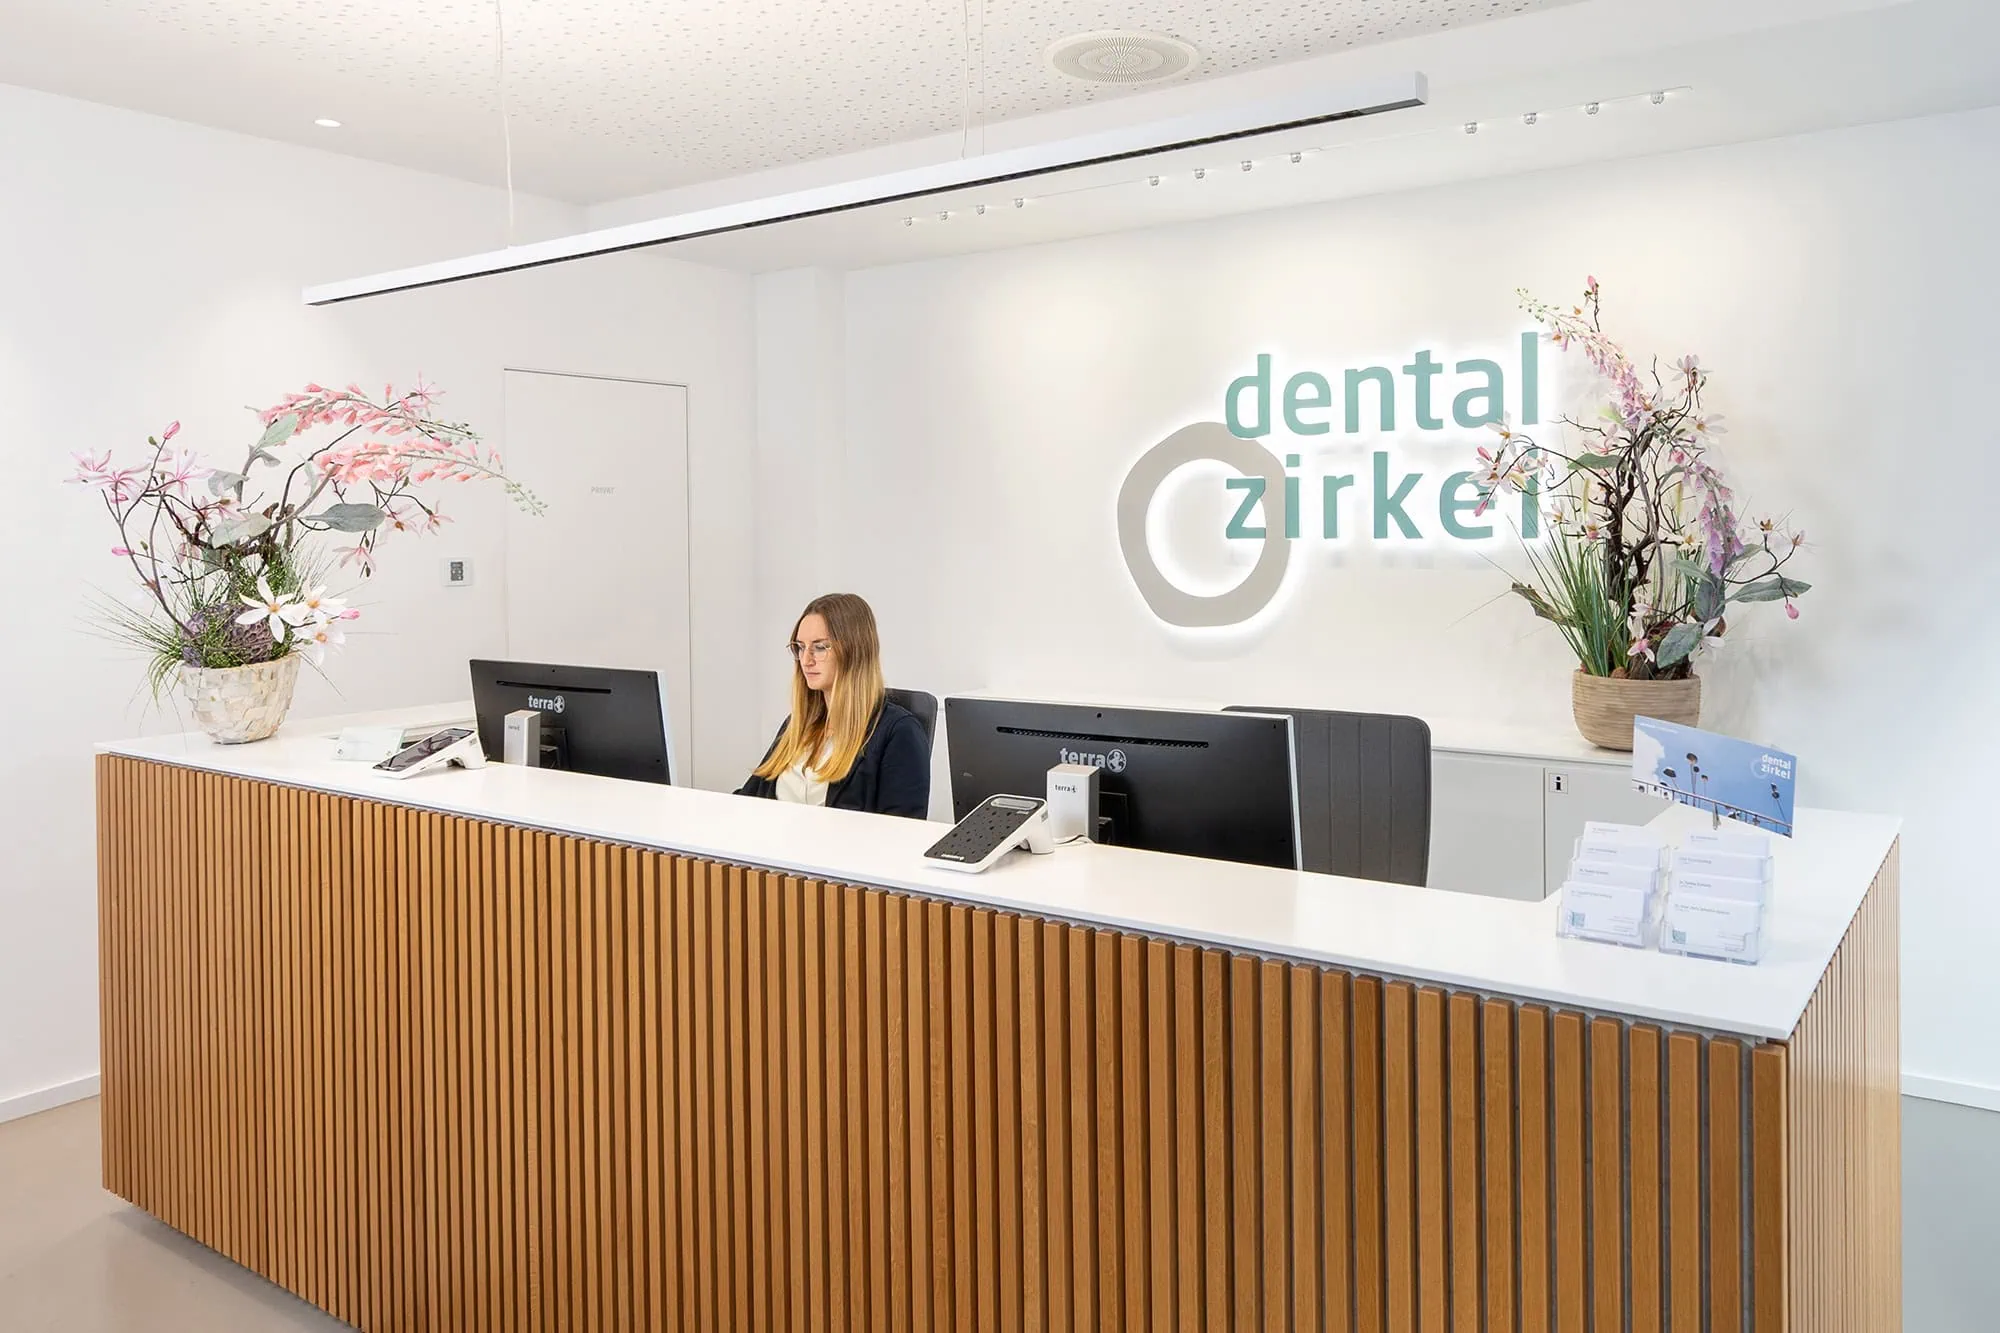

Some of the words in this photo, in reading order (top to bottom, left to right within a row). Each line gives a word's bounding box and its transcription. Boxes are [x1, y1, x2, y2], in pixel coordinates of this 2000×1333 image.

[1225, 332, 1538, 439] dental
[1225, 448, 1539, 540] zirkel
[528, 695, 554, 710] terra
[1060, 748, 1106, 768] terra
[1761, 754, 1792, 770] dental
[1760, 763, 1791, 780] zirkel
